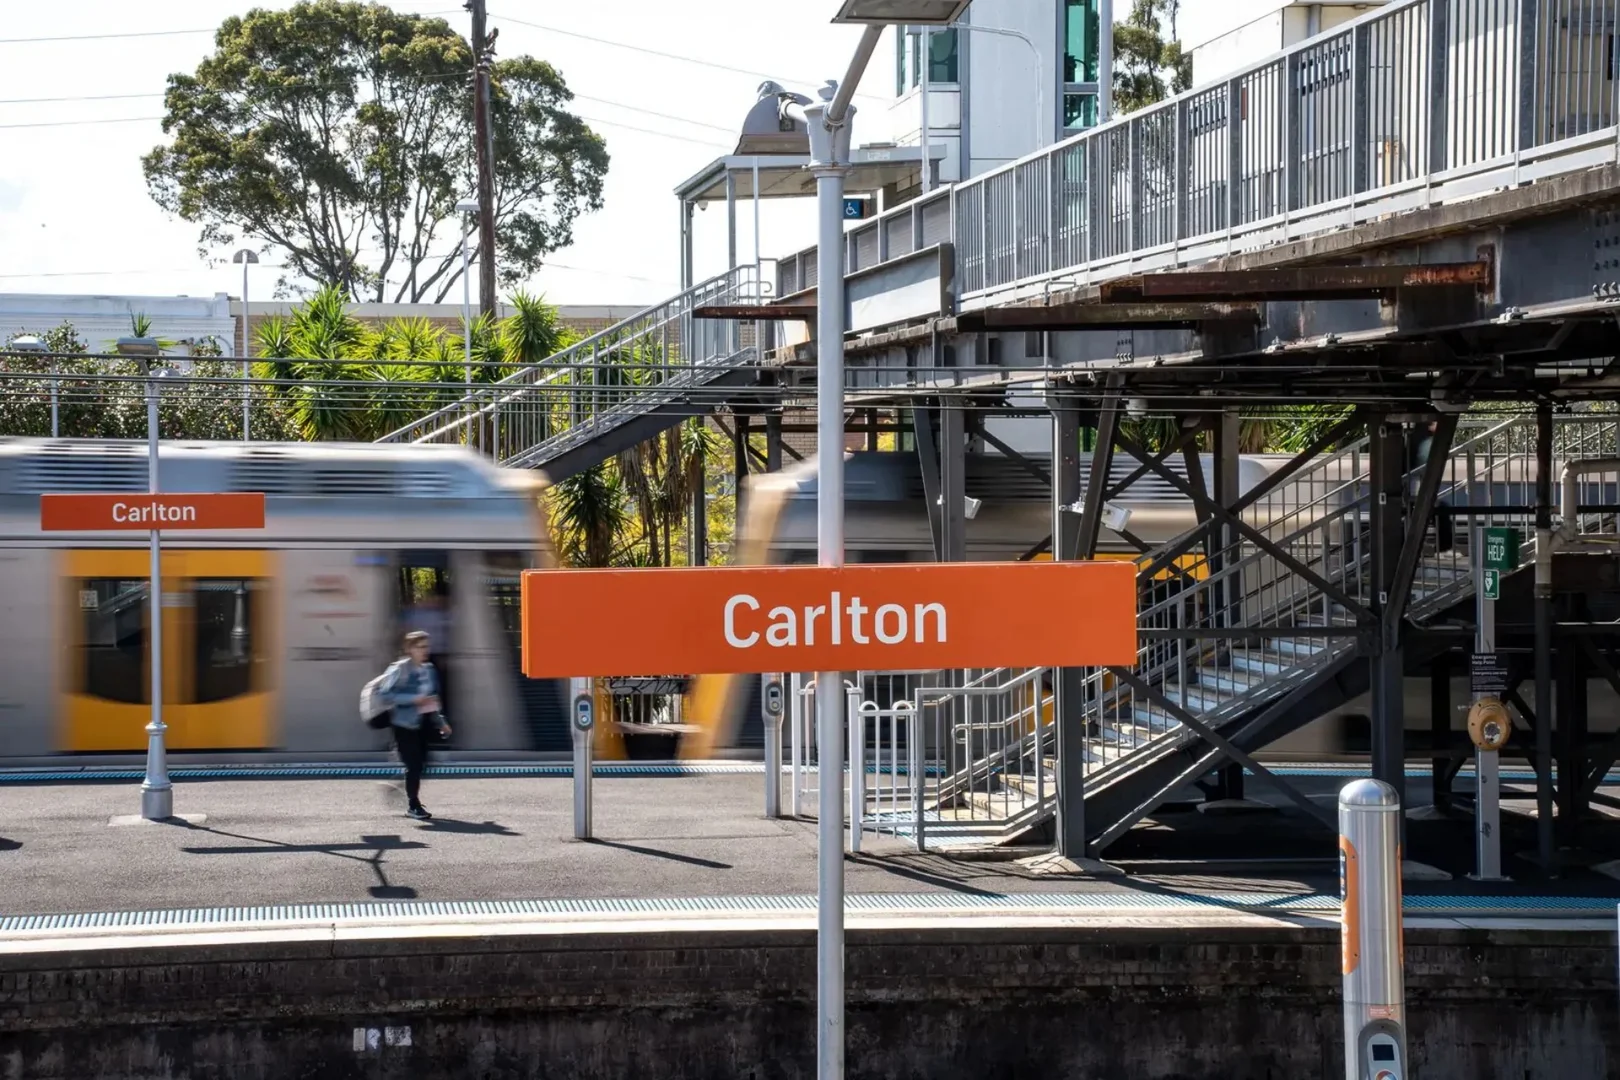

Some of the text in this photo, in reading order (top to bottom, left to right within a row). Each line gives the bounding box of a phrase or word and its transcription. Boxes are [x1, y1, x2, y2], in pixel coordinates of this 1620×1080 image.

[111, 502, 196, 523] Carlton
[1488, 545, 1505, 561] HELP
[724, 591, 947, 648] Carlton
